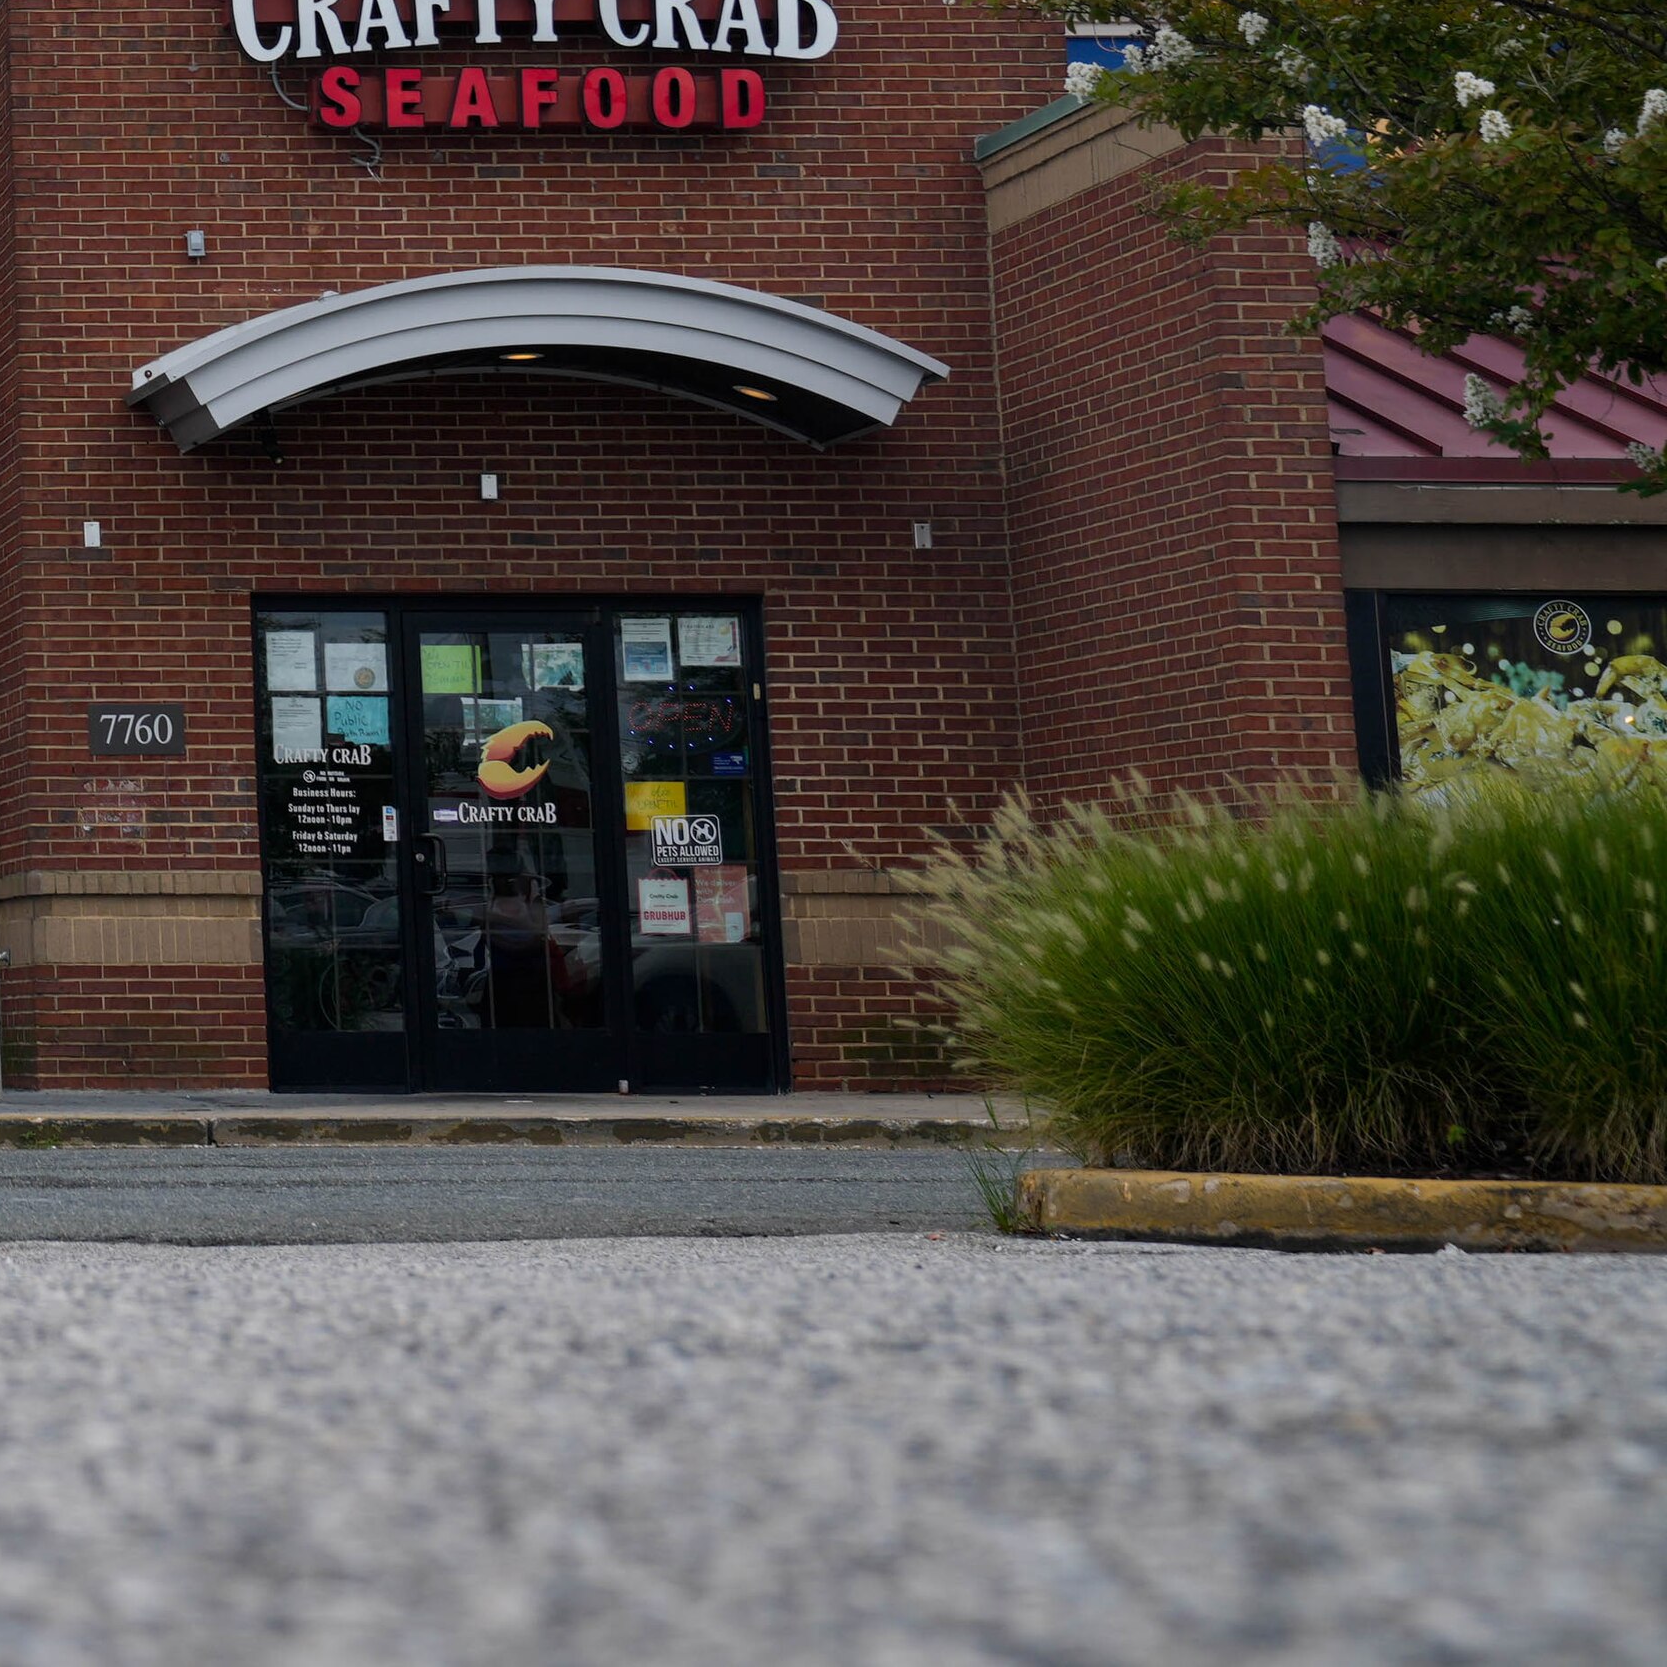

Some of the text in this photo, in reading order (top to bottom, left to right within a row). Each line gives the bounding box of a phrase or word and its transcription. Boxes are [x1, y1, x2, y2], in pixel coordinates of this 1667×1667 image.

[317, 65, 766, 130] SEAFOOD
[1537, 603, 1565, 627] CRAFTY
[628, 701, 734, 732] OPEN
[98, 713, 173, 745] 7760
[274, 743, 372, 766] CRAFTY CRAB
[292, 787, 357, 798] Business Hours:
[288, 803, 315, 814] Sunday
[316, 804, 325, 813] to
[458, 802, 514, 824] CRAFTY
[517, 802, 557, 824] CRAB
[298, 814, 326, 824] 12noon
[332, 814, 352, 826] 10pm
[292, 831, 358, 843] Friday & Saturday
[654, 818, 690, 846] NO
[298, 843, 327, 852] 12noon
[657, 845, 719, 857] PETS ALLOWED
[643, 910, 686, 921] GRUBHUB
